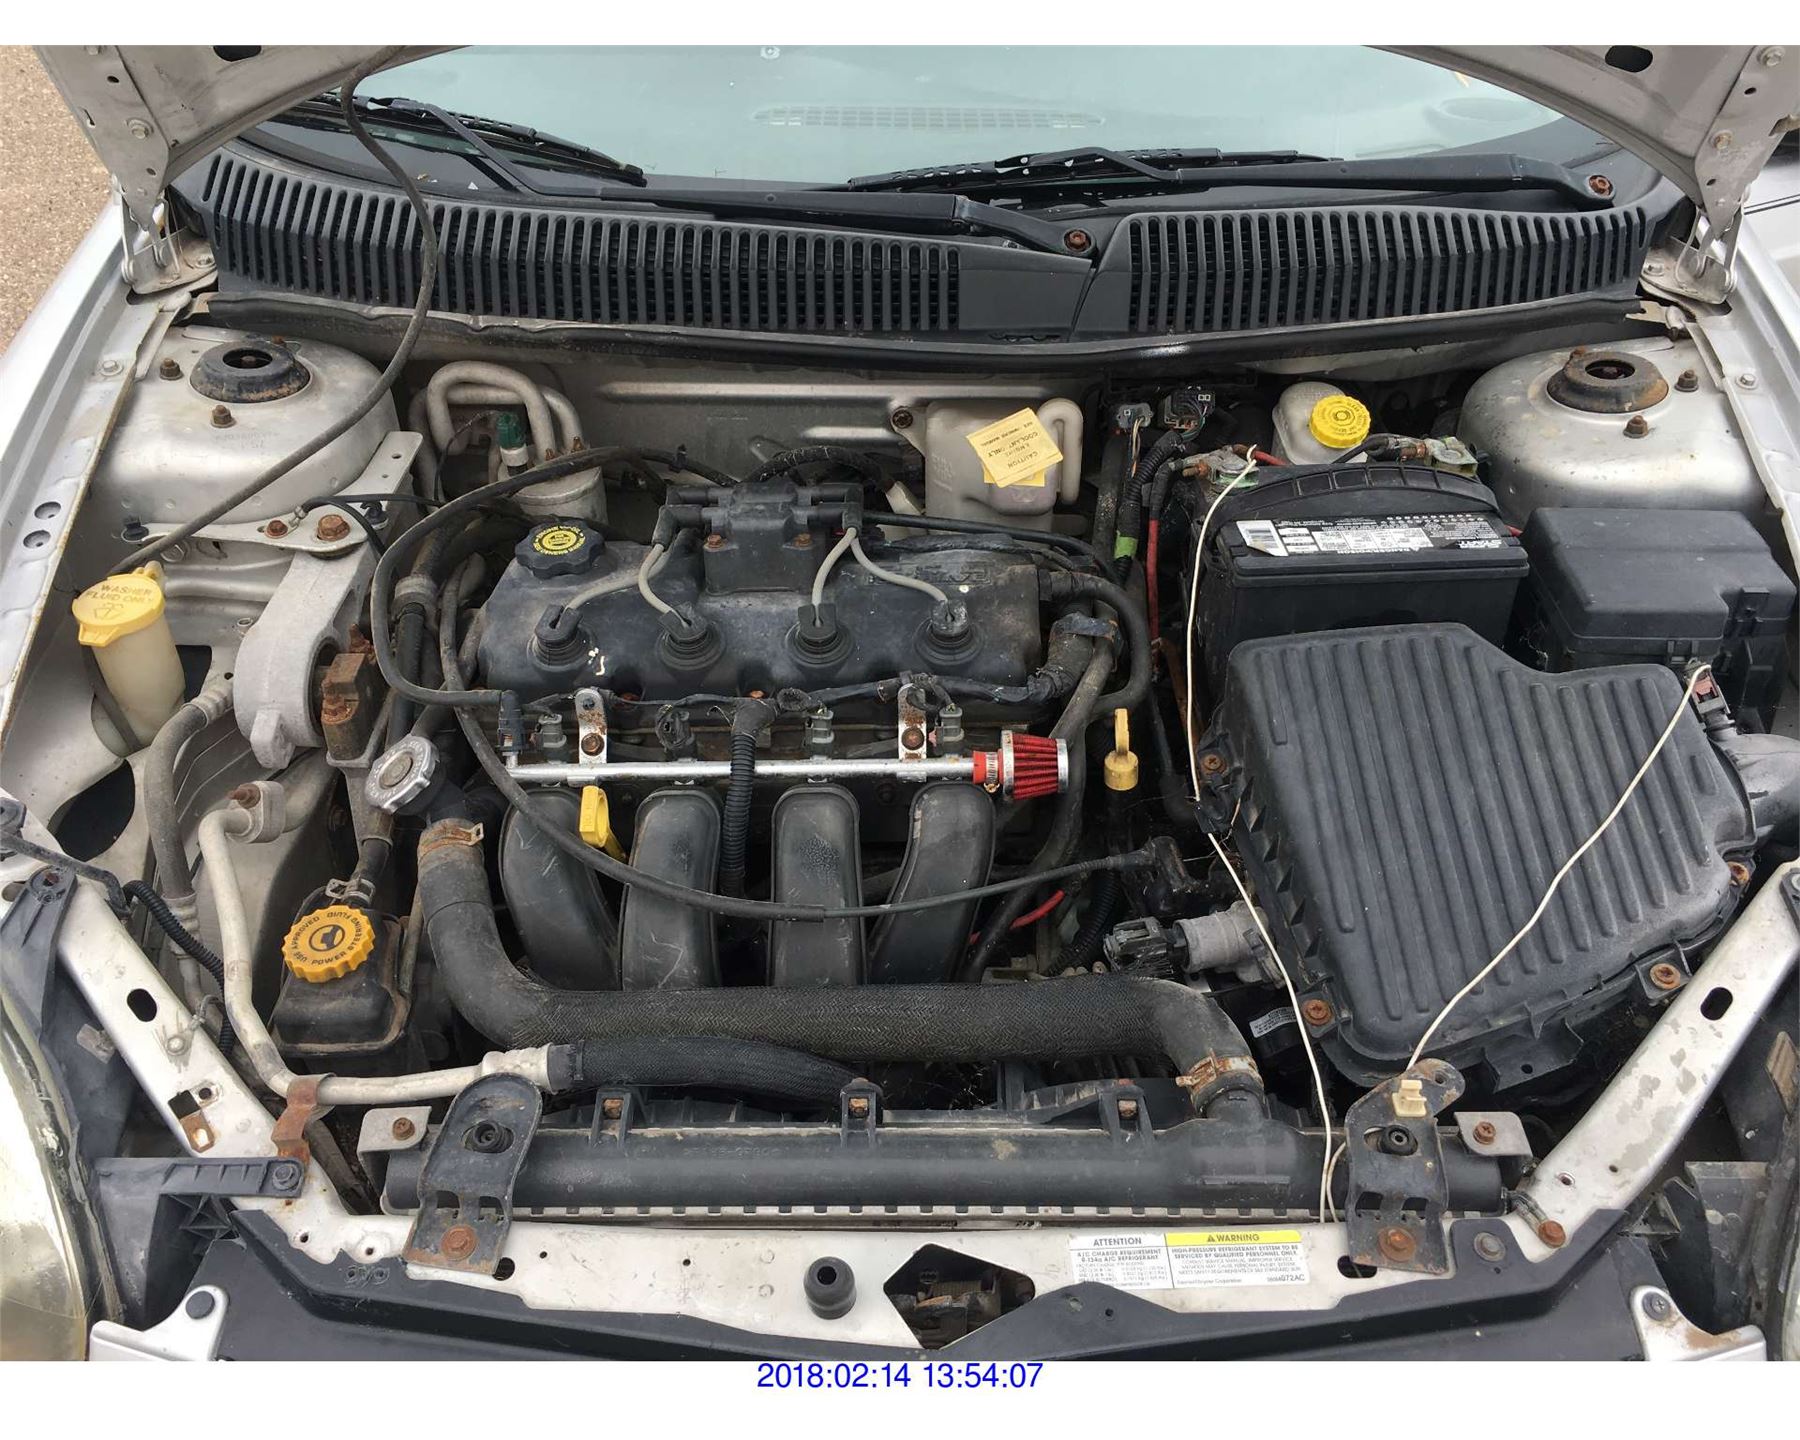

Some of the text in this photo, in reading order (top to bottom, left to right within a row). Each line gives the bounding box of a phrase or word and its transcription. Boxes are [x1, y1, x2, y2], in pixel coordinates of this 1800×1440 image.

[988, 447, 1006, 458] ONLY
[1007, 451, 1039, 469] CAUTION
[101, 584, 153, 595] WASHER
[86, 590, 120, 601] FLUID
[291, 916, 320, 950] APPROVED
[311, 911, 363, 965] POWER STEERING FLUID
[1093, 1237, 1142, 1247] ATTENTION
[1217, 1233, 1260, 1242] WARNING
